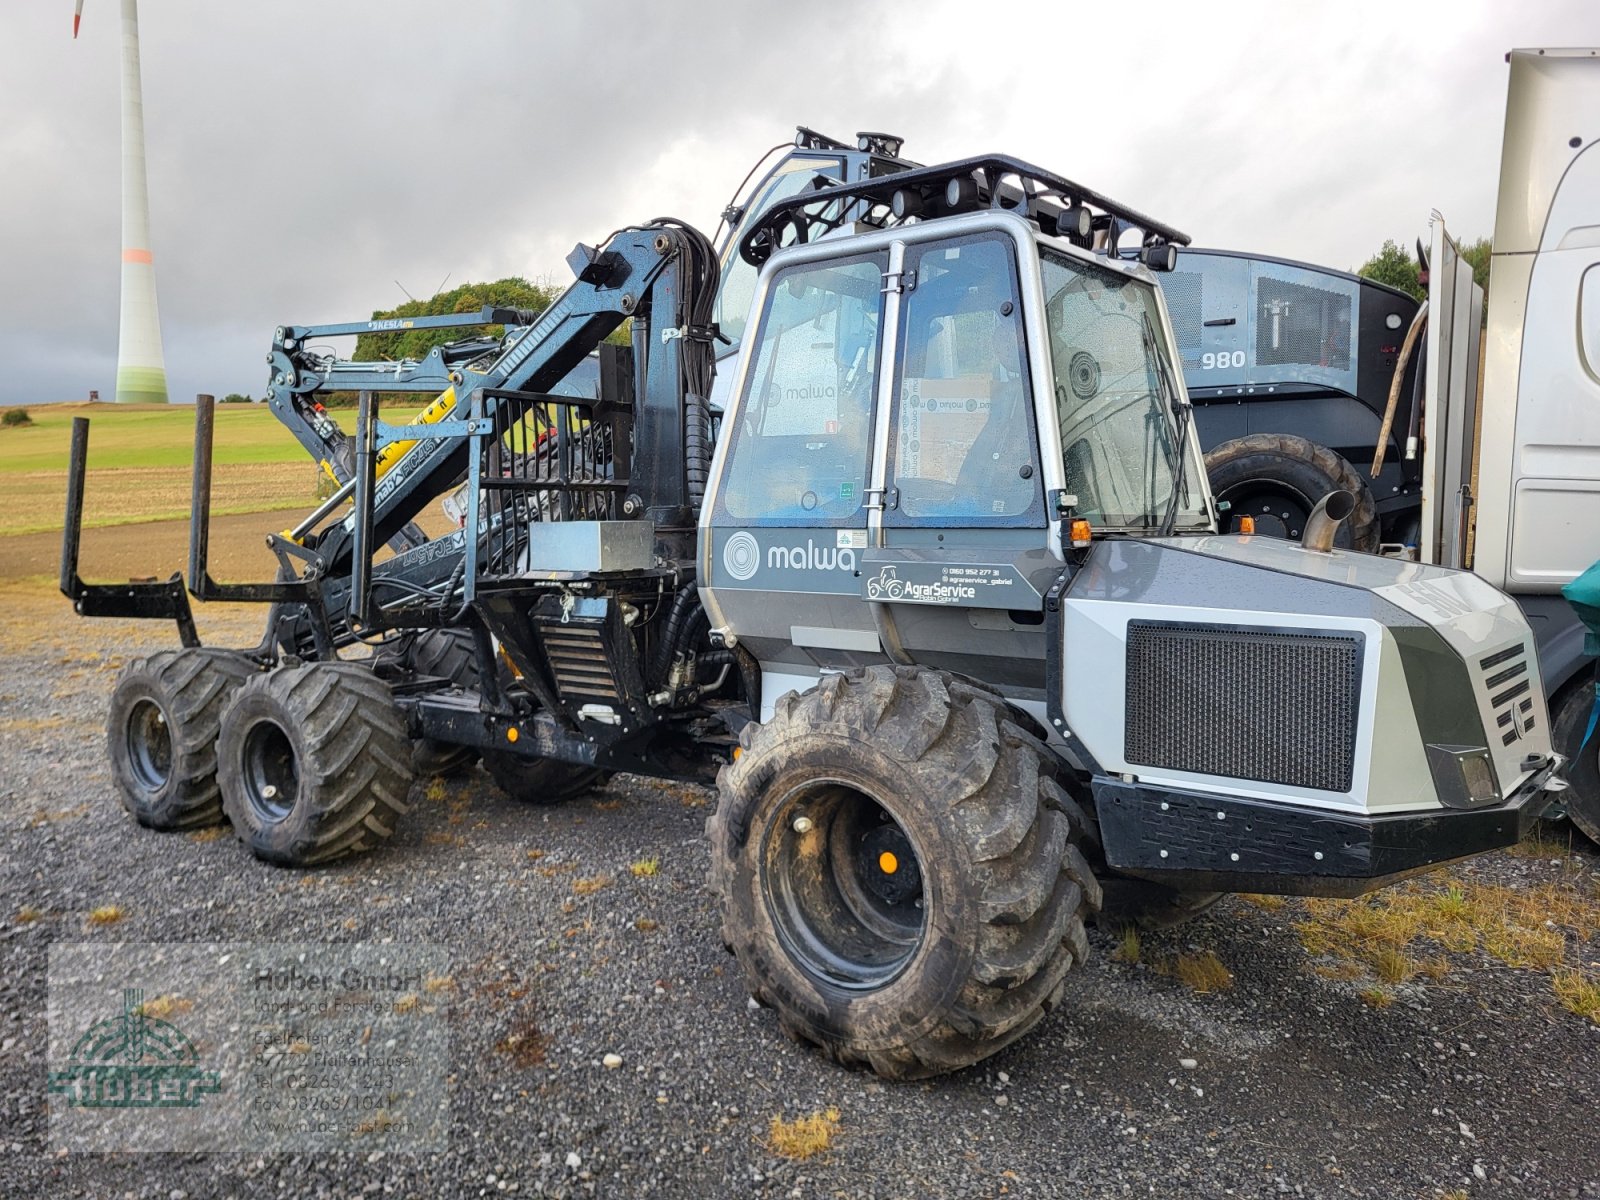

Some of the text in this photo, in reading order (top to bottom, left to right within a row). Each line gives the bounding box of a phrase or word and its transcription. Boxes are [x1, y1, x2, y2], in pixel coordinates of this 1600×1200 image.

[1202, 350, 1246, 370] 980
[786, 383, 835, 399] malwa
[767, 539, 856, 571] malwa
[904, 581, 975, 598] AgrarService
